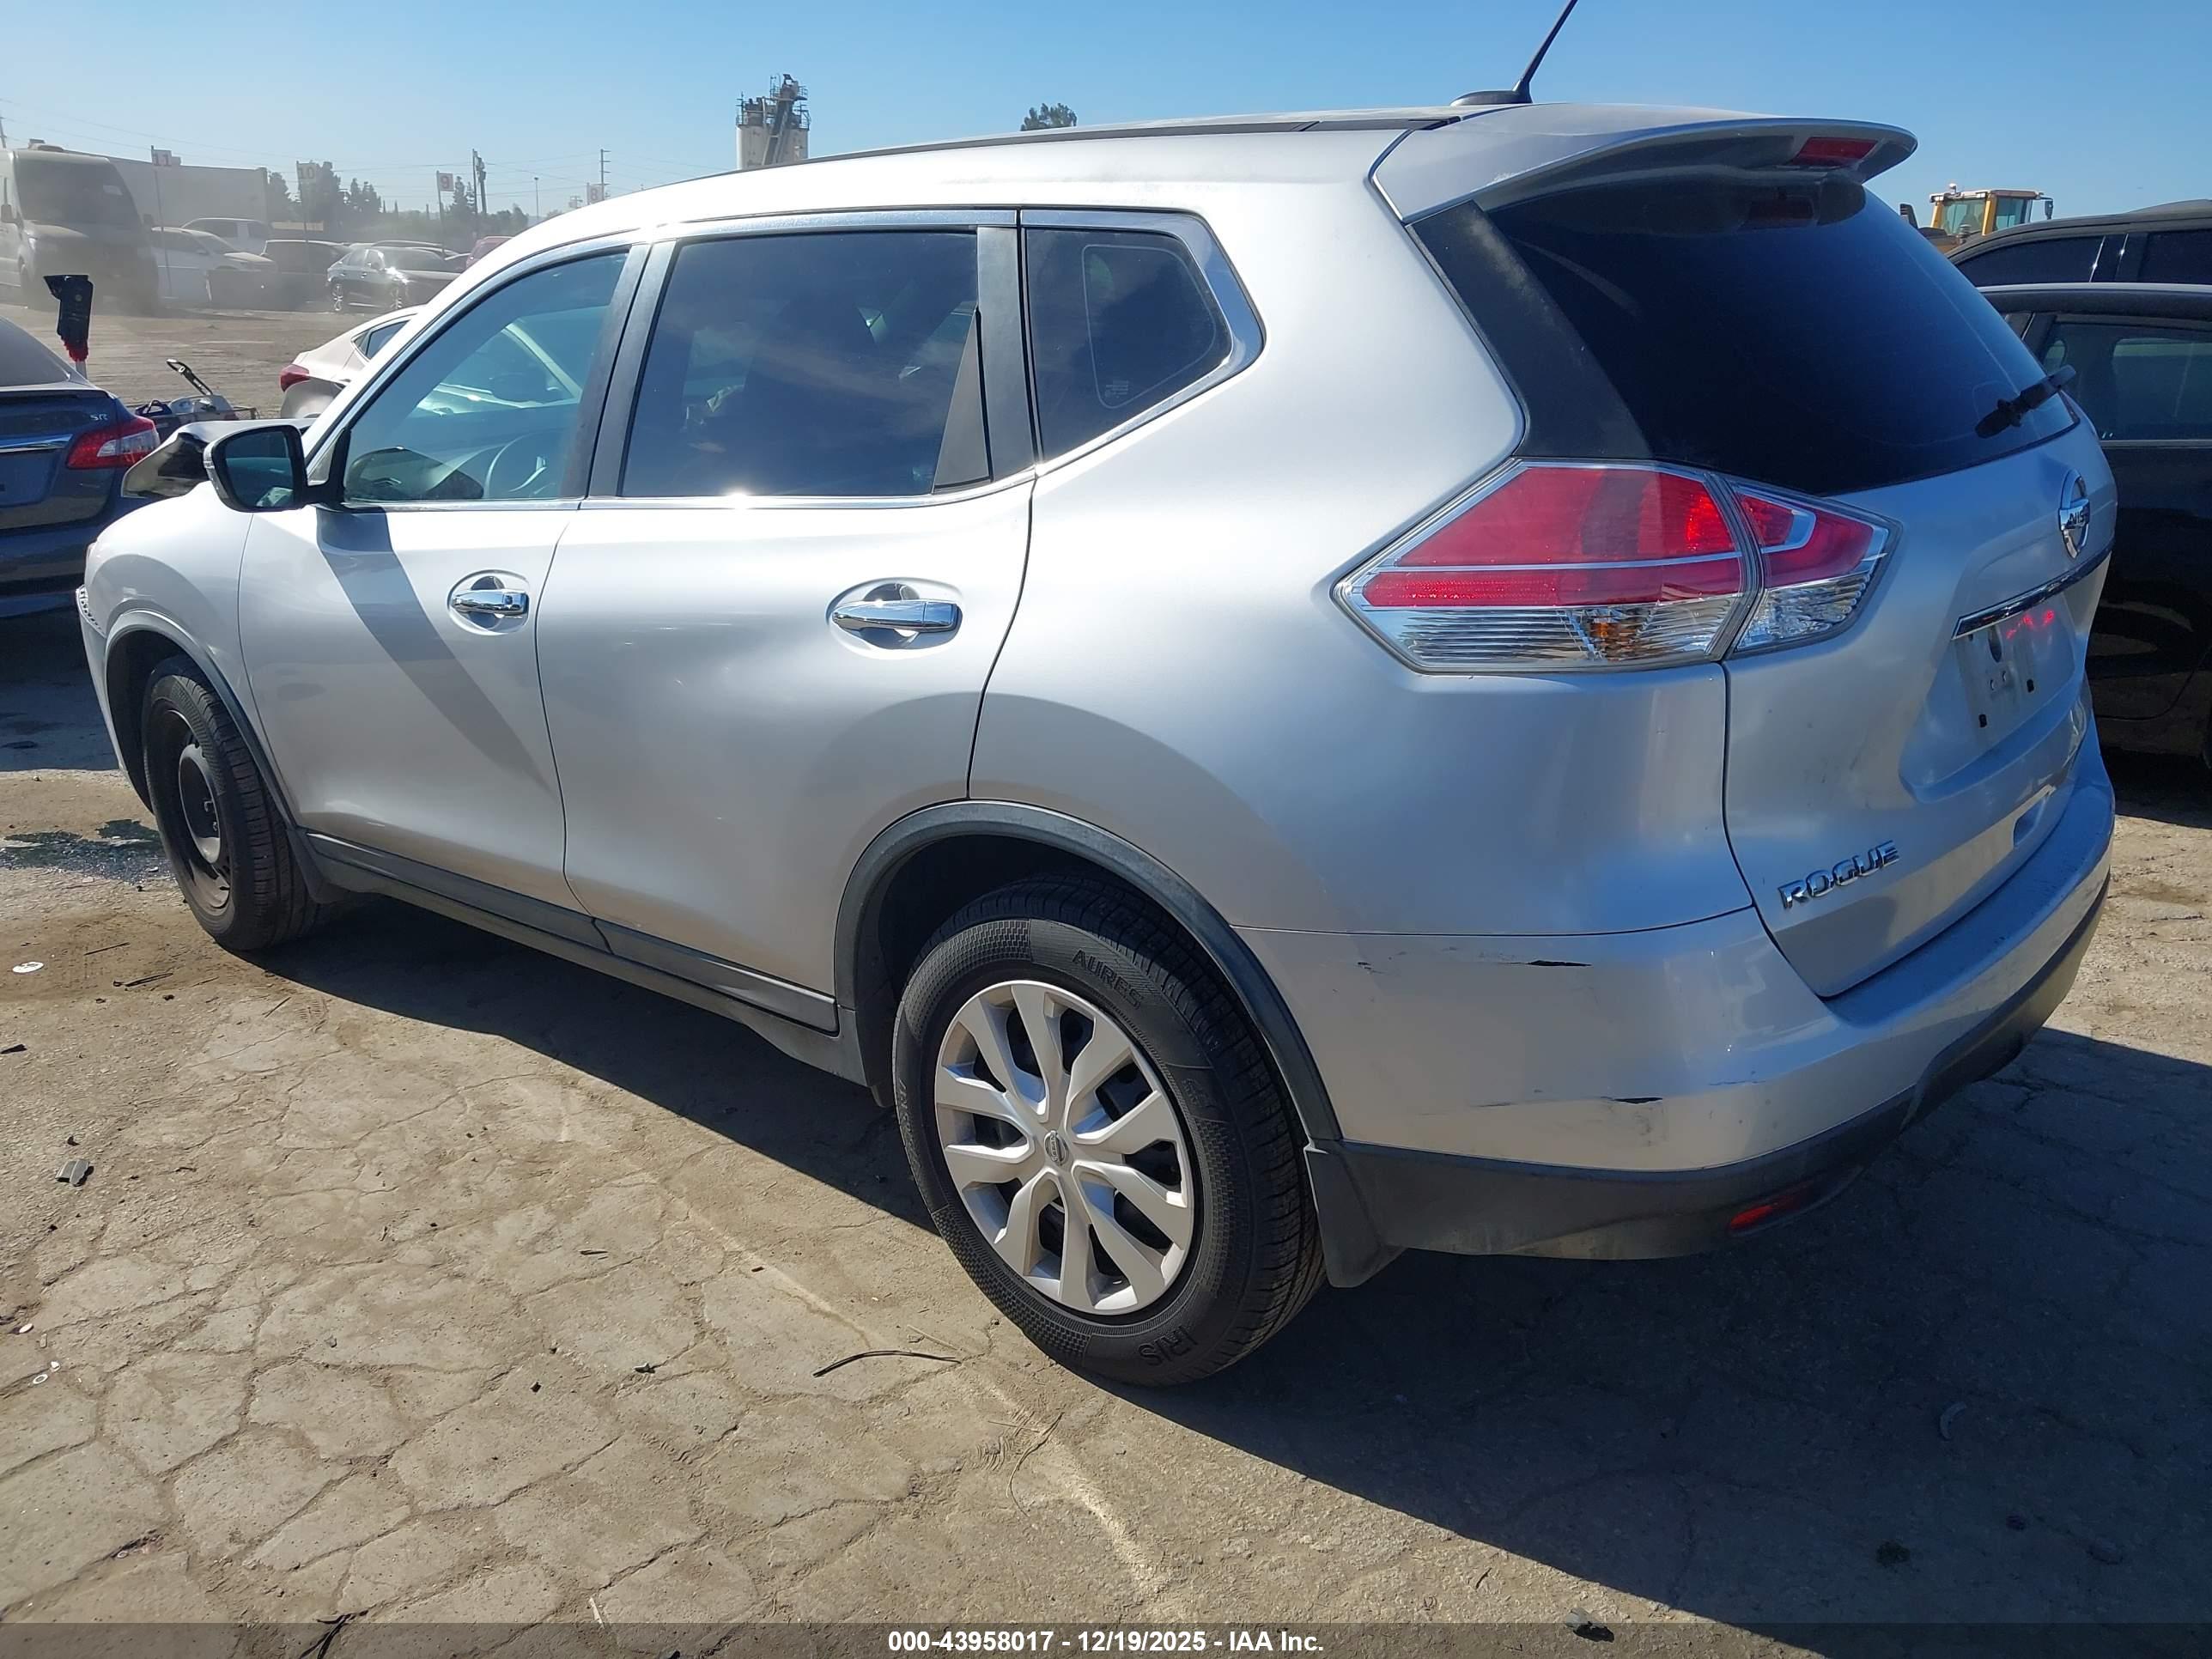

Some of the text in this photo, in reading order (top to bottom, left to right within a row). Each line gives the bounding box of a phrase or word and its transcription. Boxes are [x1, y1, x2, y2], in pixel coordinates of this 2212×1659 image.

[440, 176, 451, 189] 9
[1778, 840, 1900, 910] ROGUE
[1072, 948, 1145, 1010] AURES
